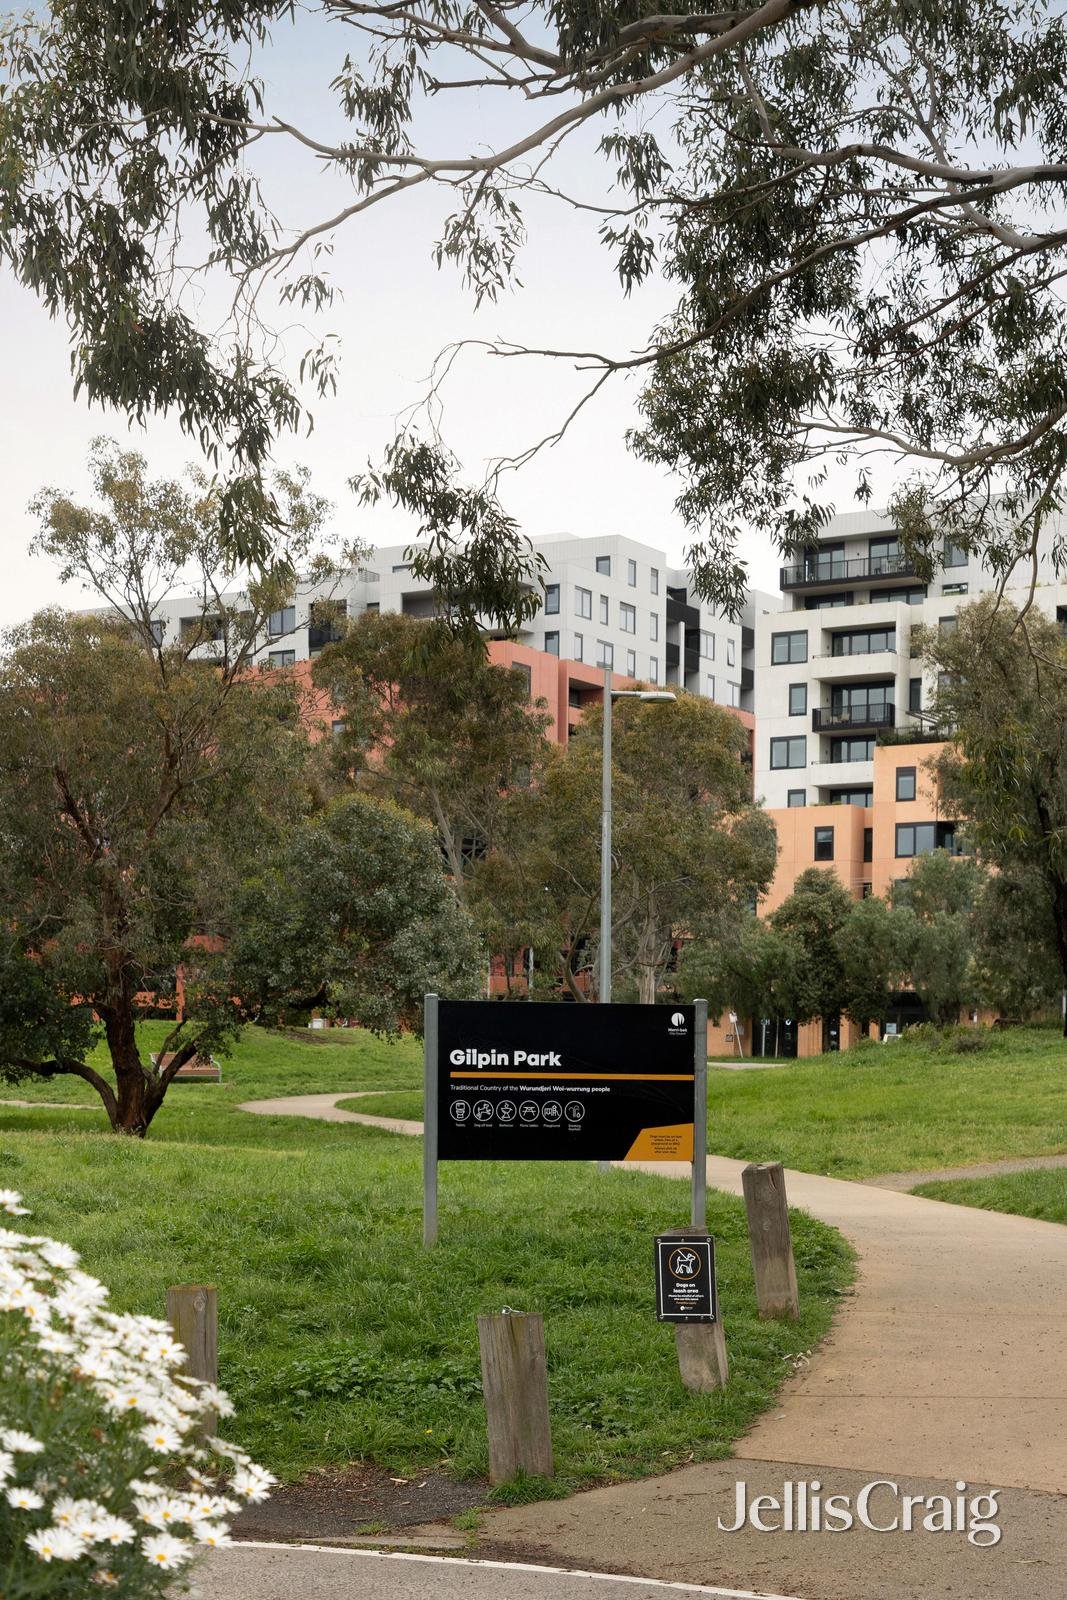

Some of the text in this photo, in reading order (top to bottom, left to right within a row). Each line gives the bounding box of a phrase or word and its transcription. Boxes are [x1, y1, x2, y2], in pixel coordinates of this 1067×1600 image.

[450, 1049, 562, 1069] Gilpin Park
[553, 1085, 590, 1093] Woi-wurrung
